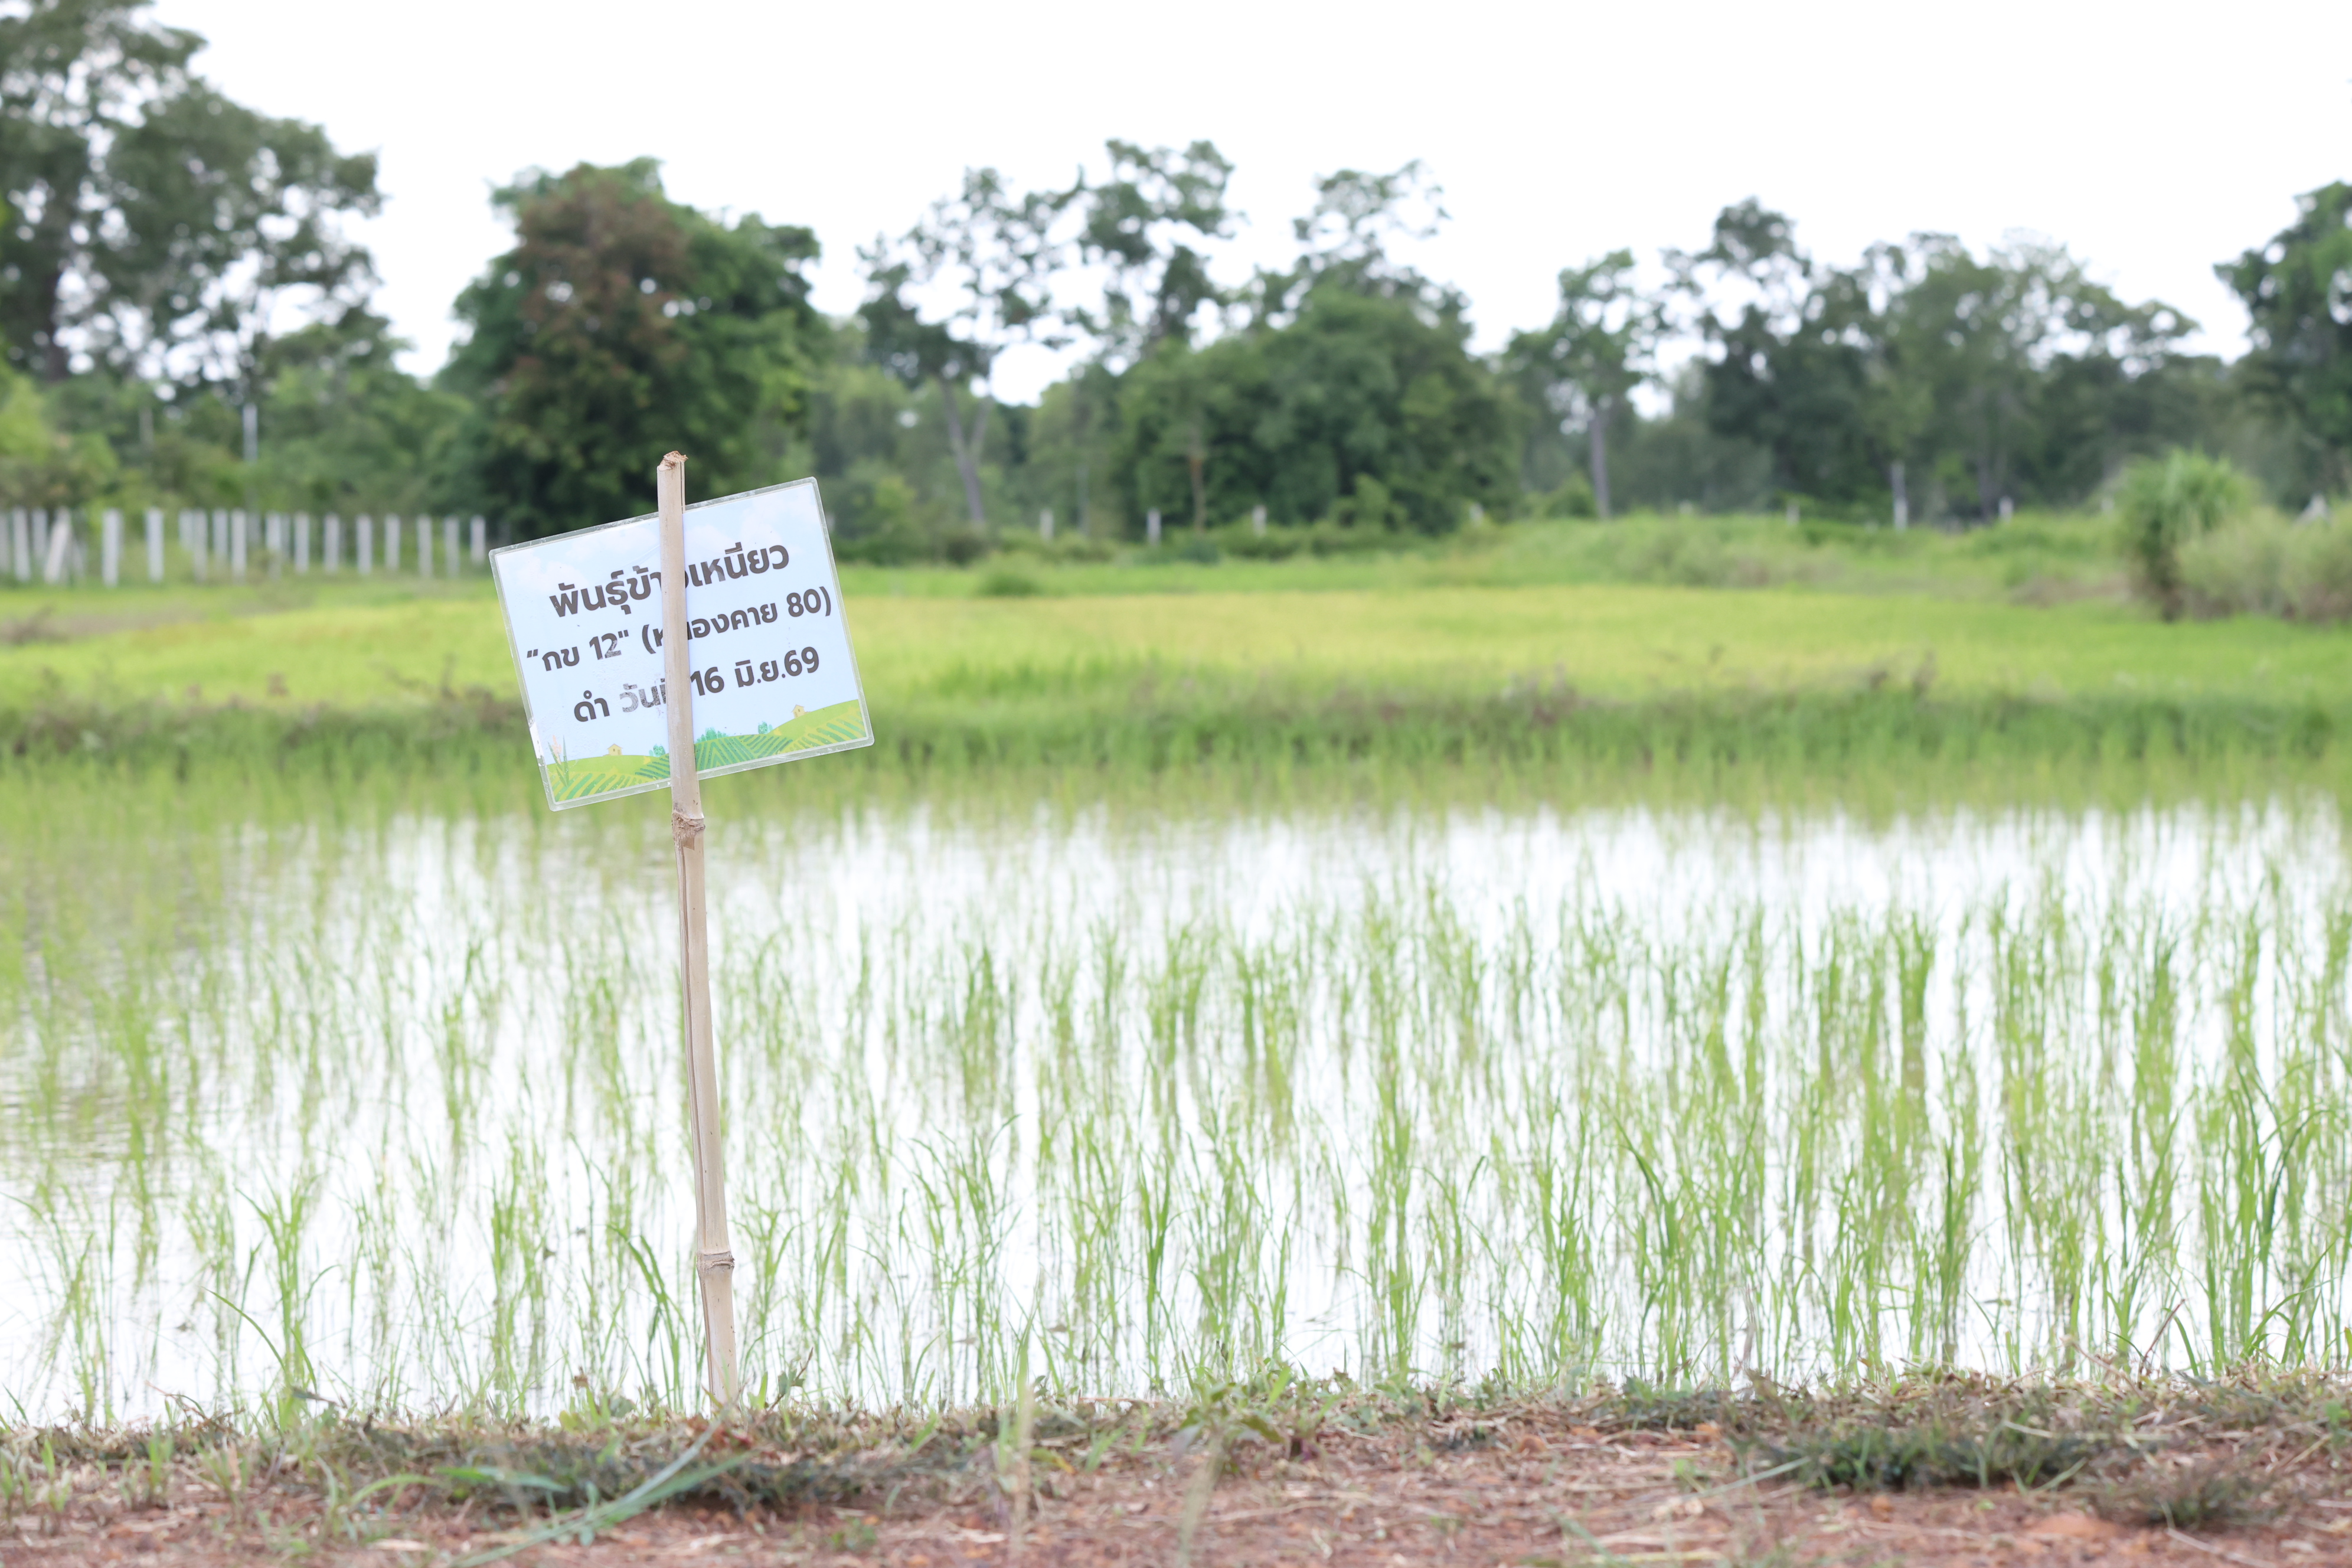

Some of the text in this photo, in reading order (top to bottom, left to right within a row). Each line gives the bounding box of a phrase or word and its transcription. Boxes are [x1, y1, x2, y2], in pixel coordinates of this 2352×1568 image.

[549, 541, 789, 618] พันธุ์ข้าเหนียว
[642, 602, 778, 655] (หองคาย
[786, 586, 832, 618] 80)
[573, 690, 610, 723] ดำ
[690, 666, 725, 697] 16
[734, 646, 819, 688] มิ.ย.69
